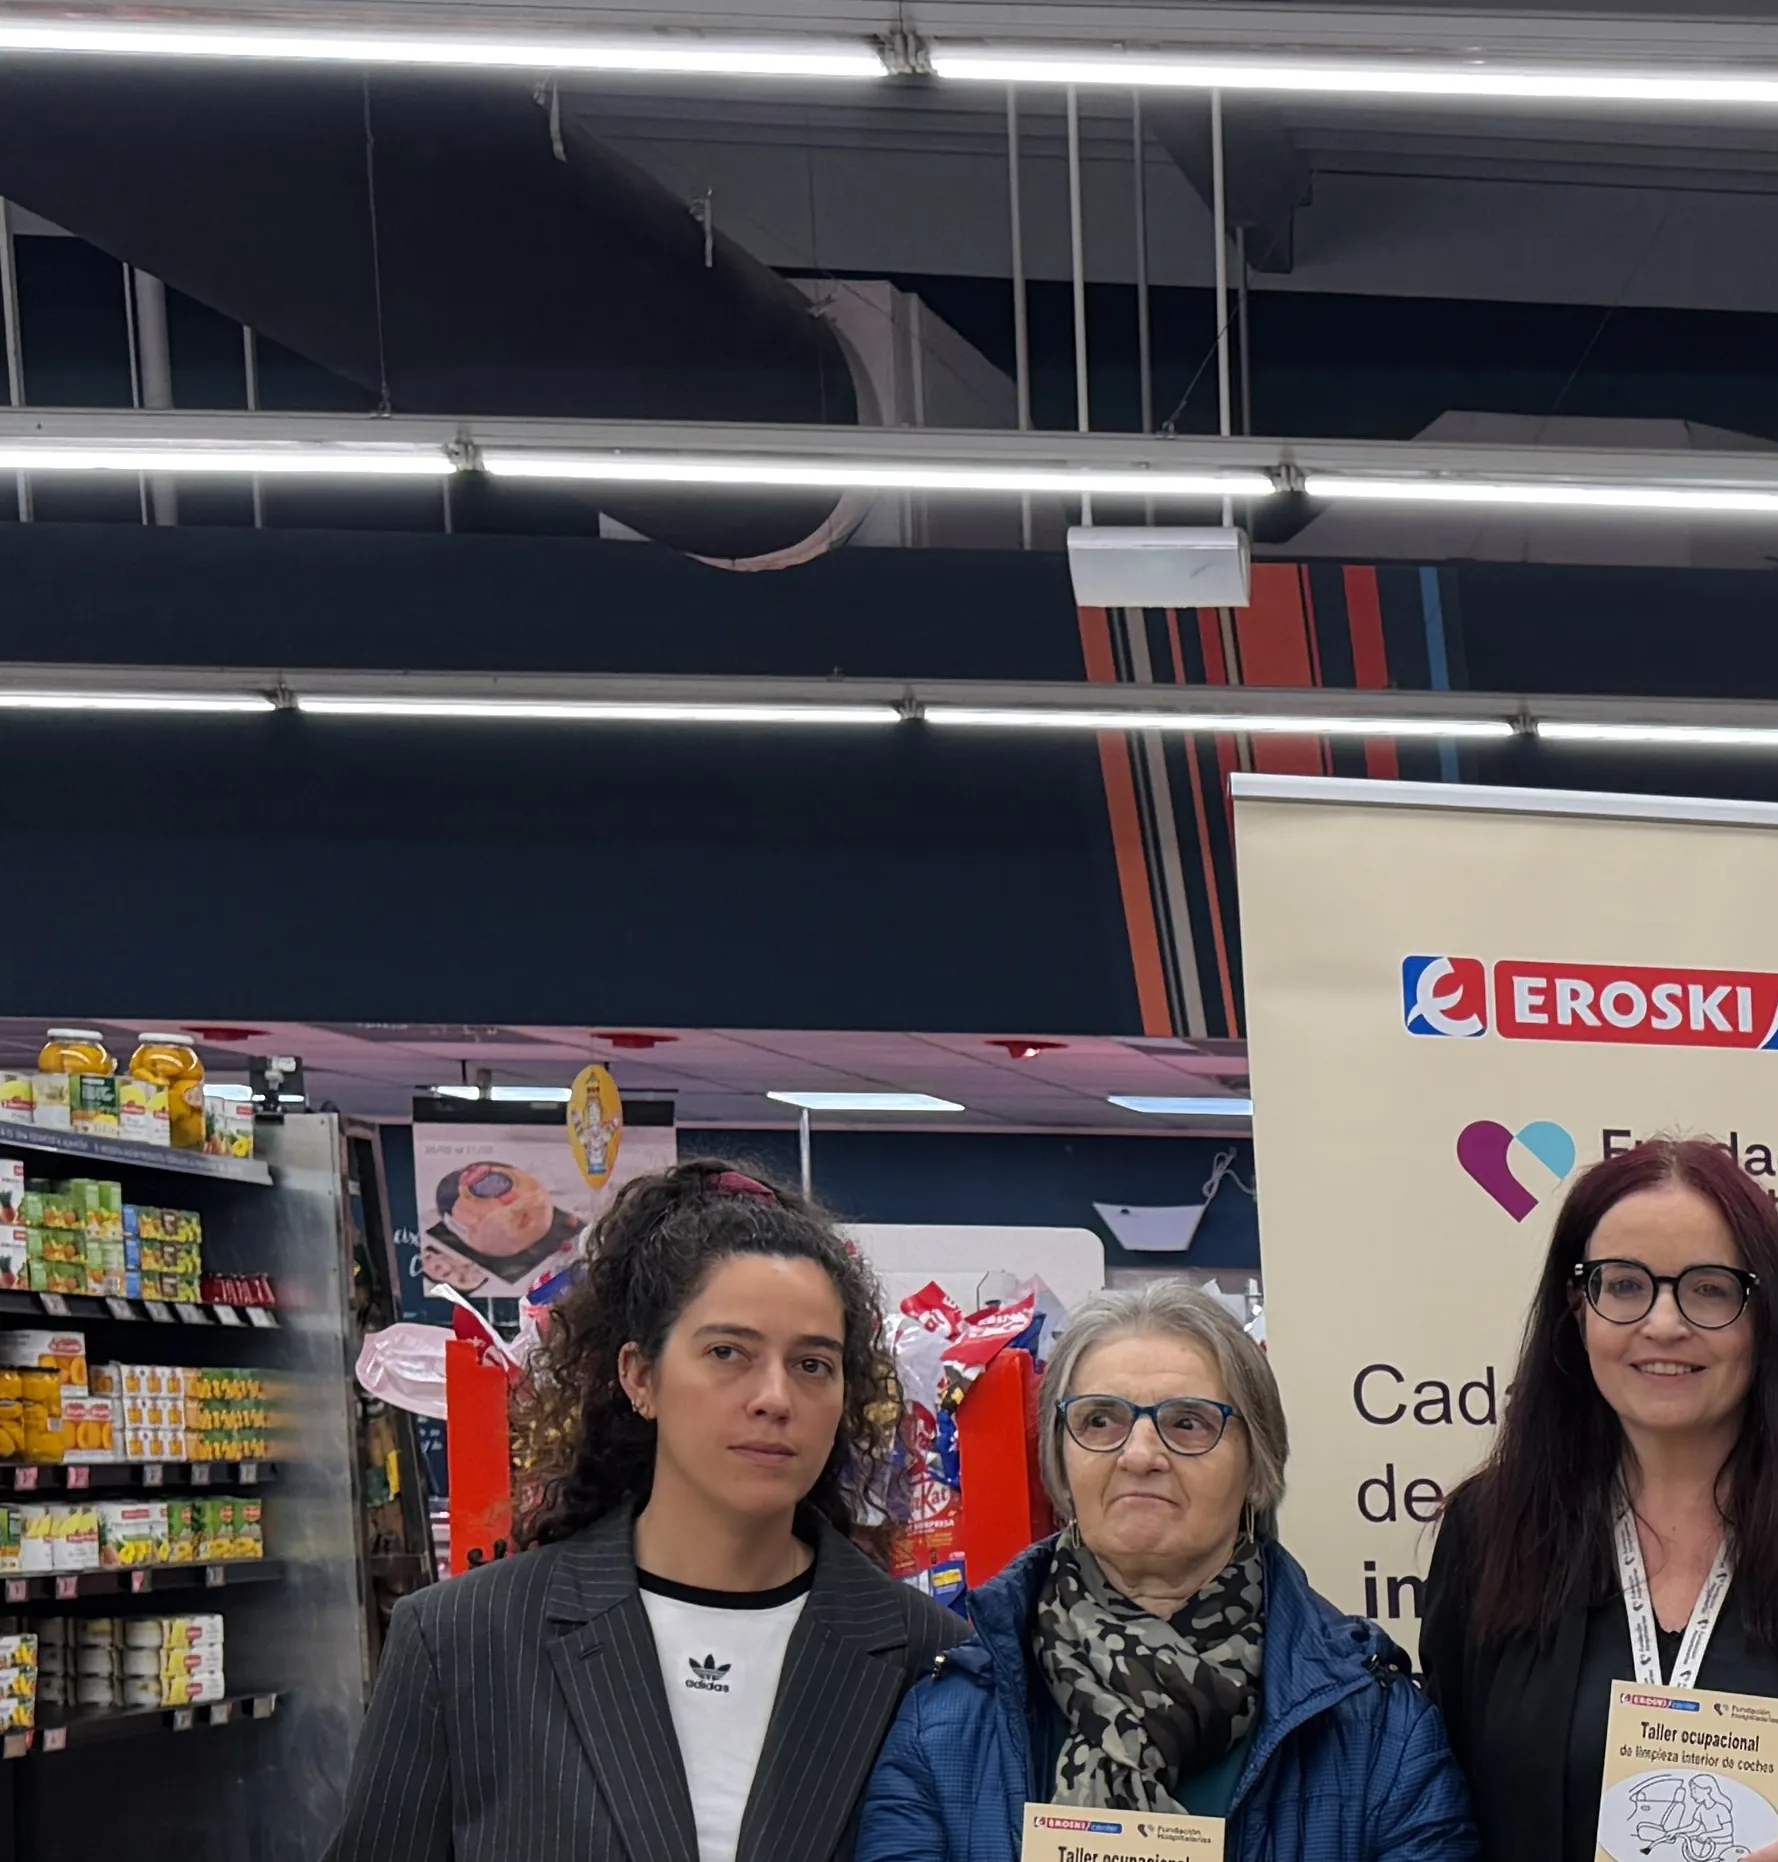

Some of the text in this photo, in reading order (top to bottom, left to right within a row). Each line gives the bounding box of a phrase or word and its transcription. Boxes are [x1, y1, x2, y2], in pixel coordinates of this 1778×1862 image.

[1513, 975, 1754, 1035] EROSKI
[1353, 1363, 1500, 1426] Cad
[685, 1678, 730, 1693] adidas
[1639, 1721, 1759, 1755] Taller ocupacional
[1619, 1744, 1774, 1773] de limpieza interior de coches
